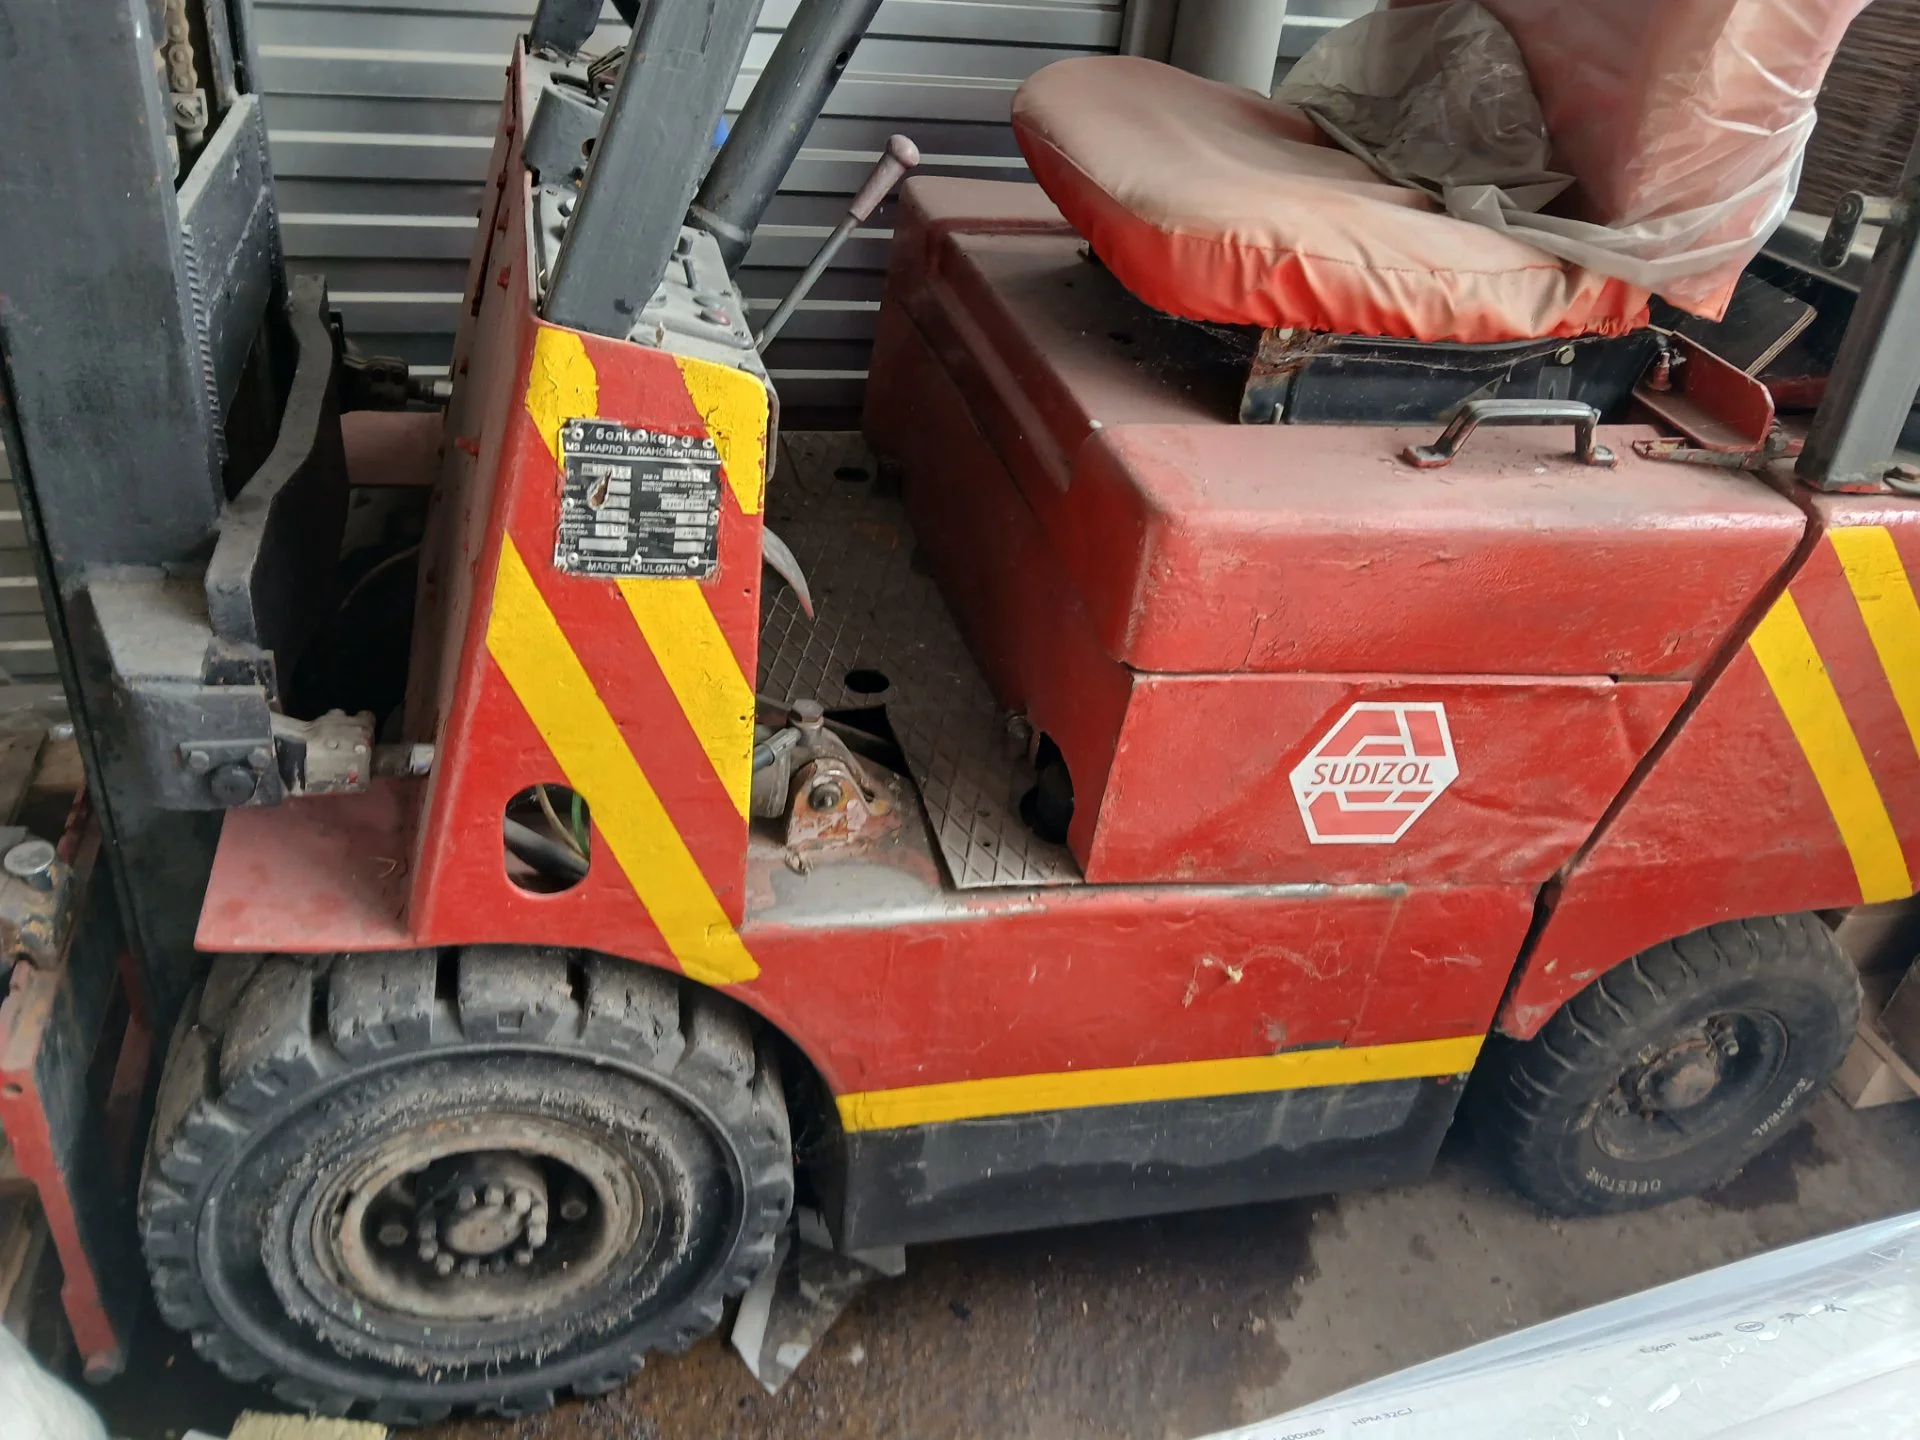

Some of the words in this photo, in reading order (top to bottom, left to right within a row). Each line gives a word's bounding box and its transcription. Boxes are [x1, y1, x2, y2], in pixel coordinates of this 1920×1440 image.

[587, 560, 617, 572] MADE
[621, 562, 632, 572] IN
[634, 562, 687, 574] BULGARIA
[1311, 762, 1434, 785] SUDIZOL
